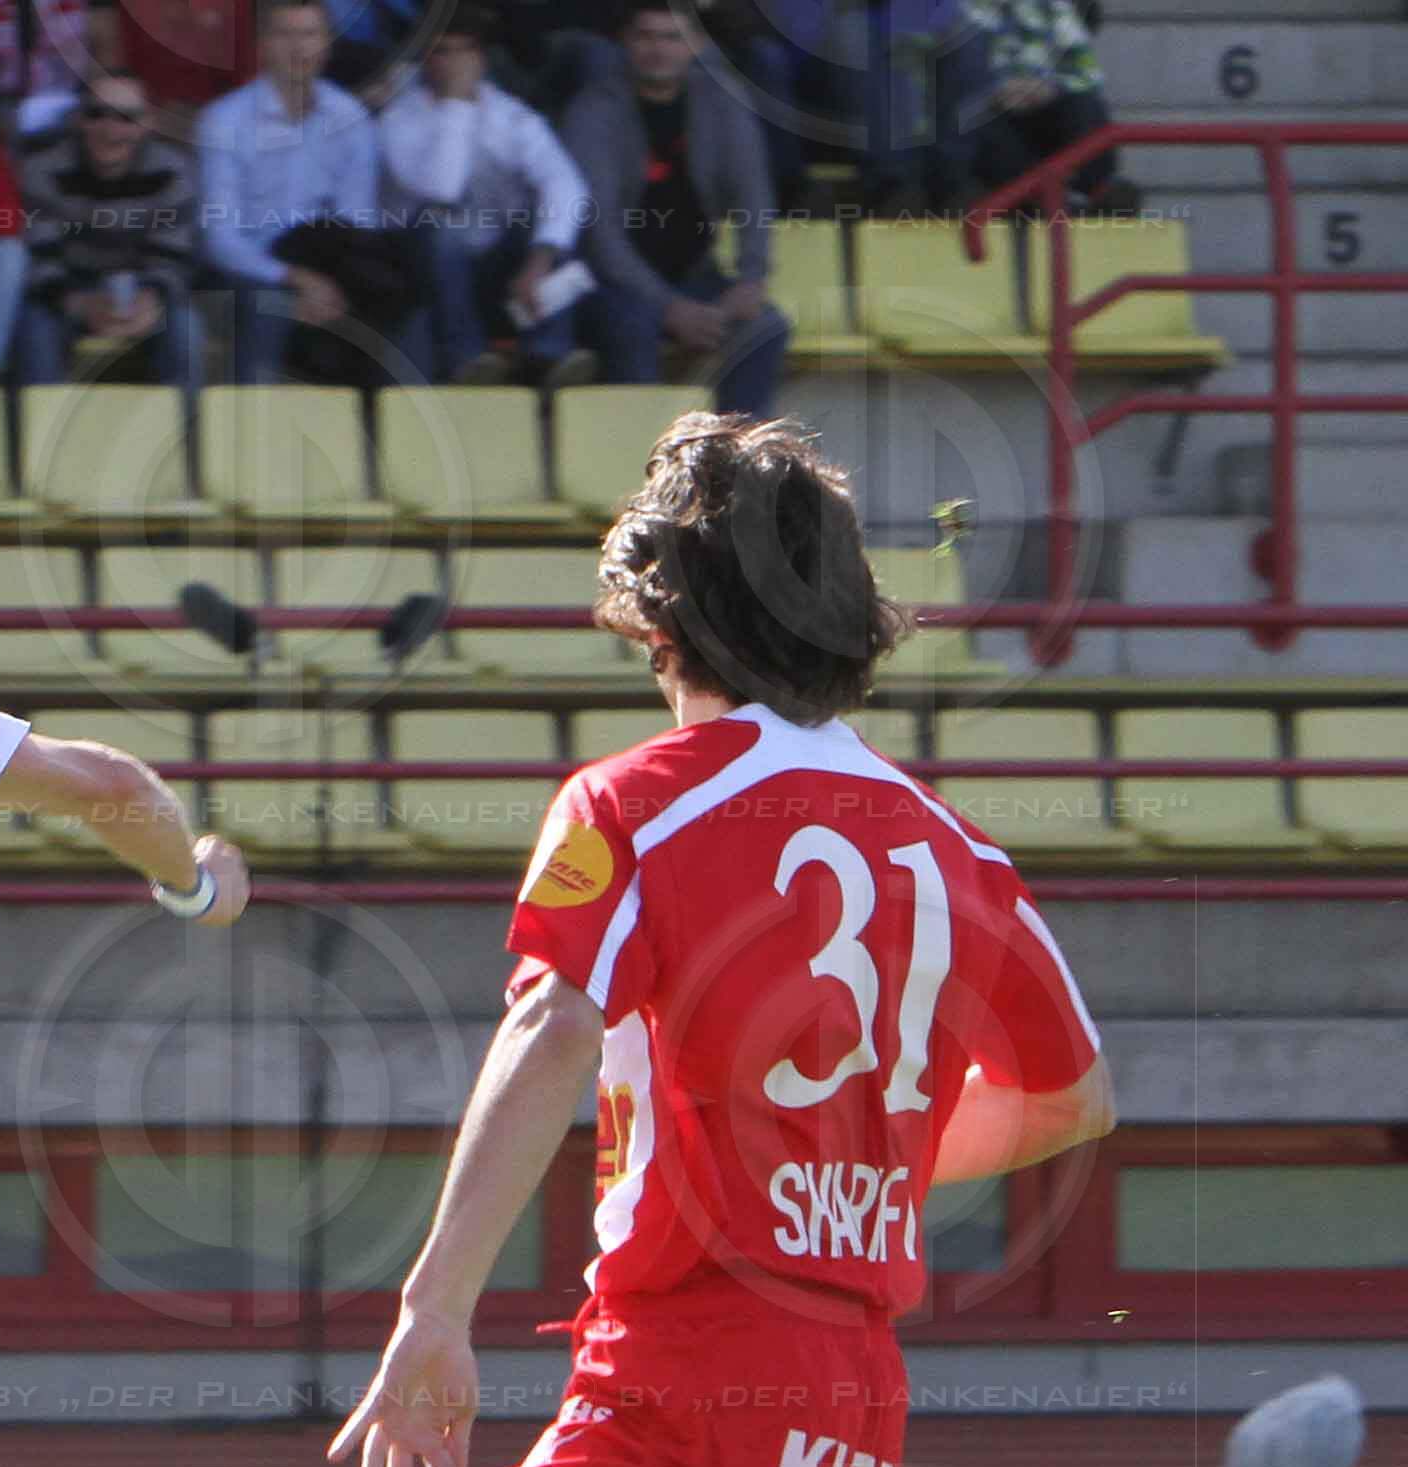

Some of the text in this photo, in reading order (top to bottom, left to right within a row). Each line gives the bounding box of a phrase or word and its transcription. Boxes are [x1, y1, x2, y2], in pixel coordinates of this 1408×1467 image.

[1220, 45, 1261, 100] 6
[1323, 211, 1361, 265] 5
[763, 824, 952, 1114] 31
